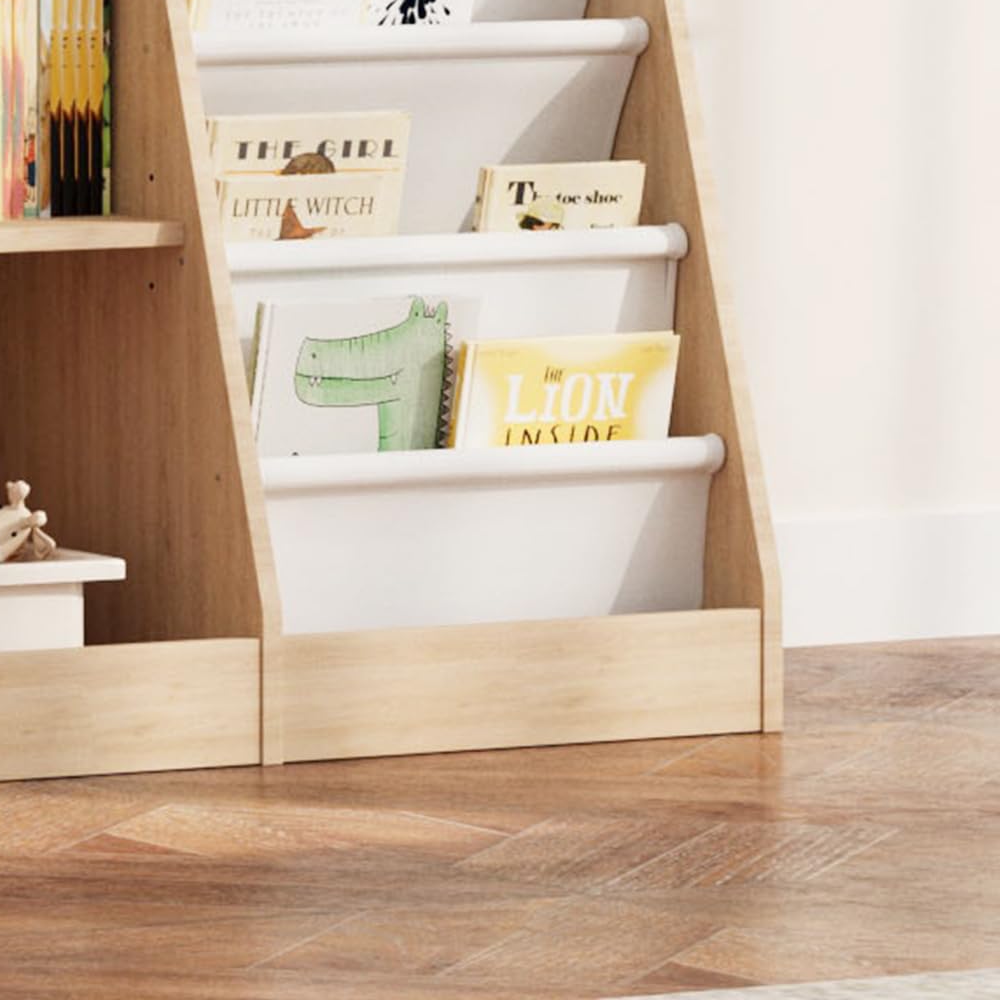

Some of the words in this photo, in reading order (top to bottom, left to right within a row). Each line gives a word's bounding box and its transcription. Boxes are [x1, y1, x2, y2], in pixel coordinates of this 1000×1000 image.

[317, 139, 399, 159] GIRL
[306, 196, 375, 216] WITCH
[503, 371, 635, 424] LION
[504, 424, 623, 447] INSIDE
